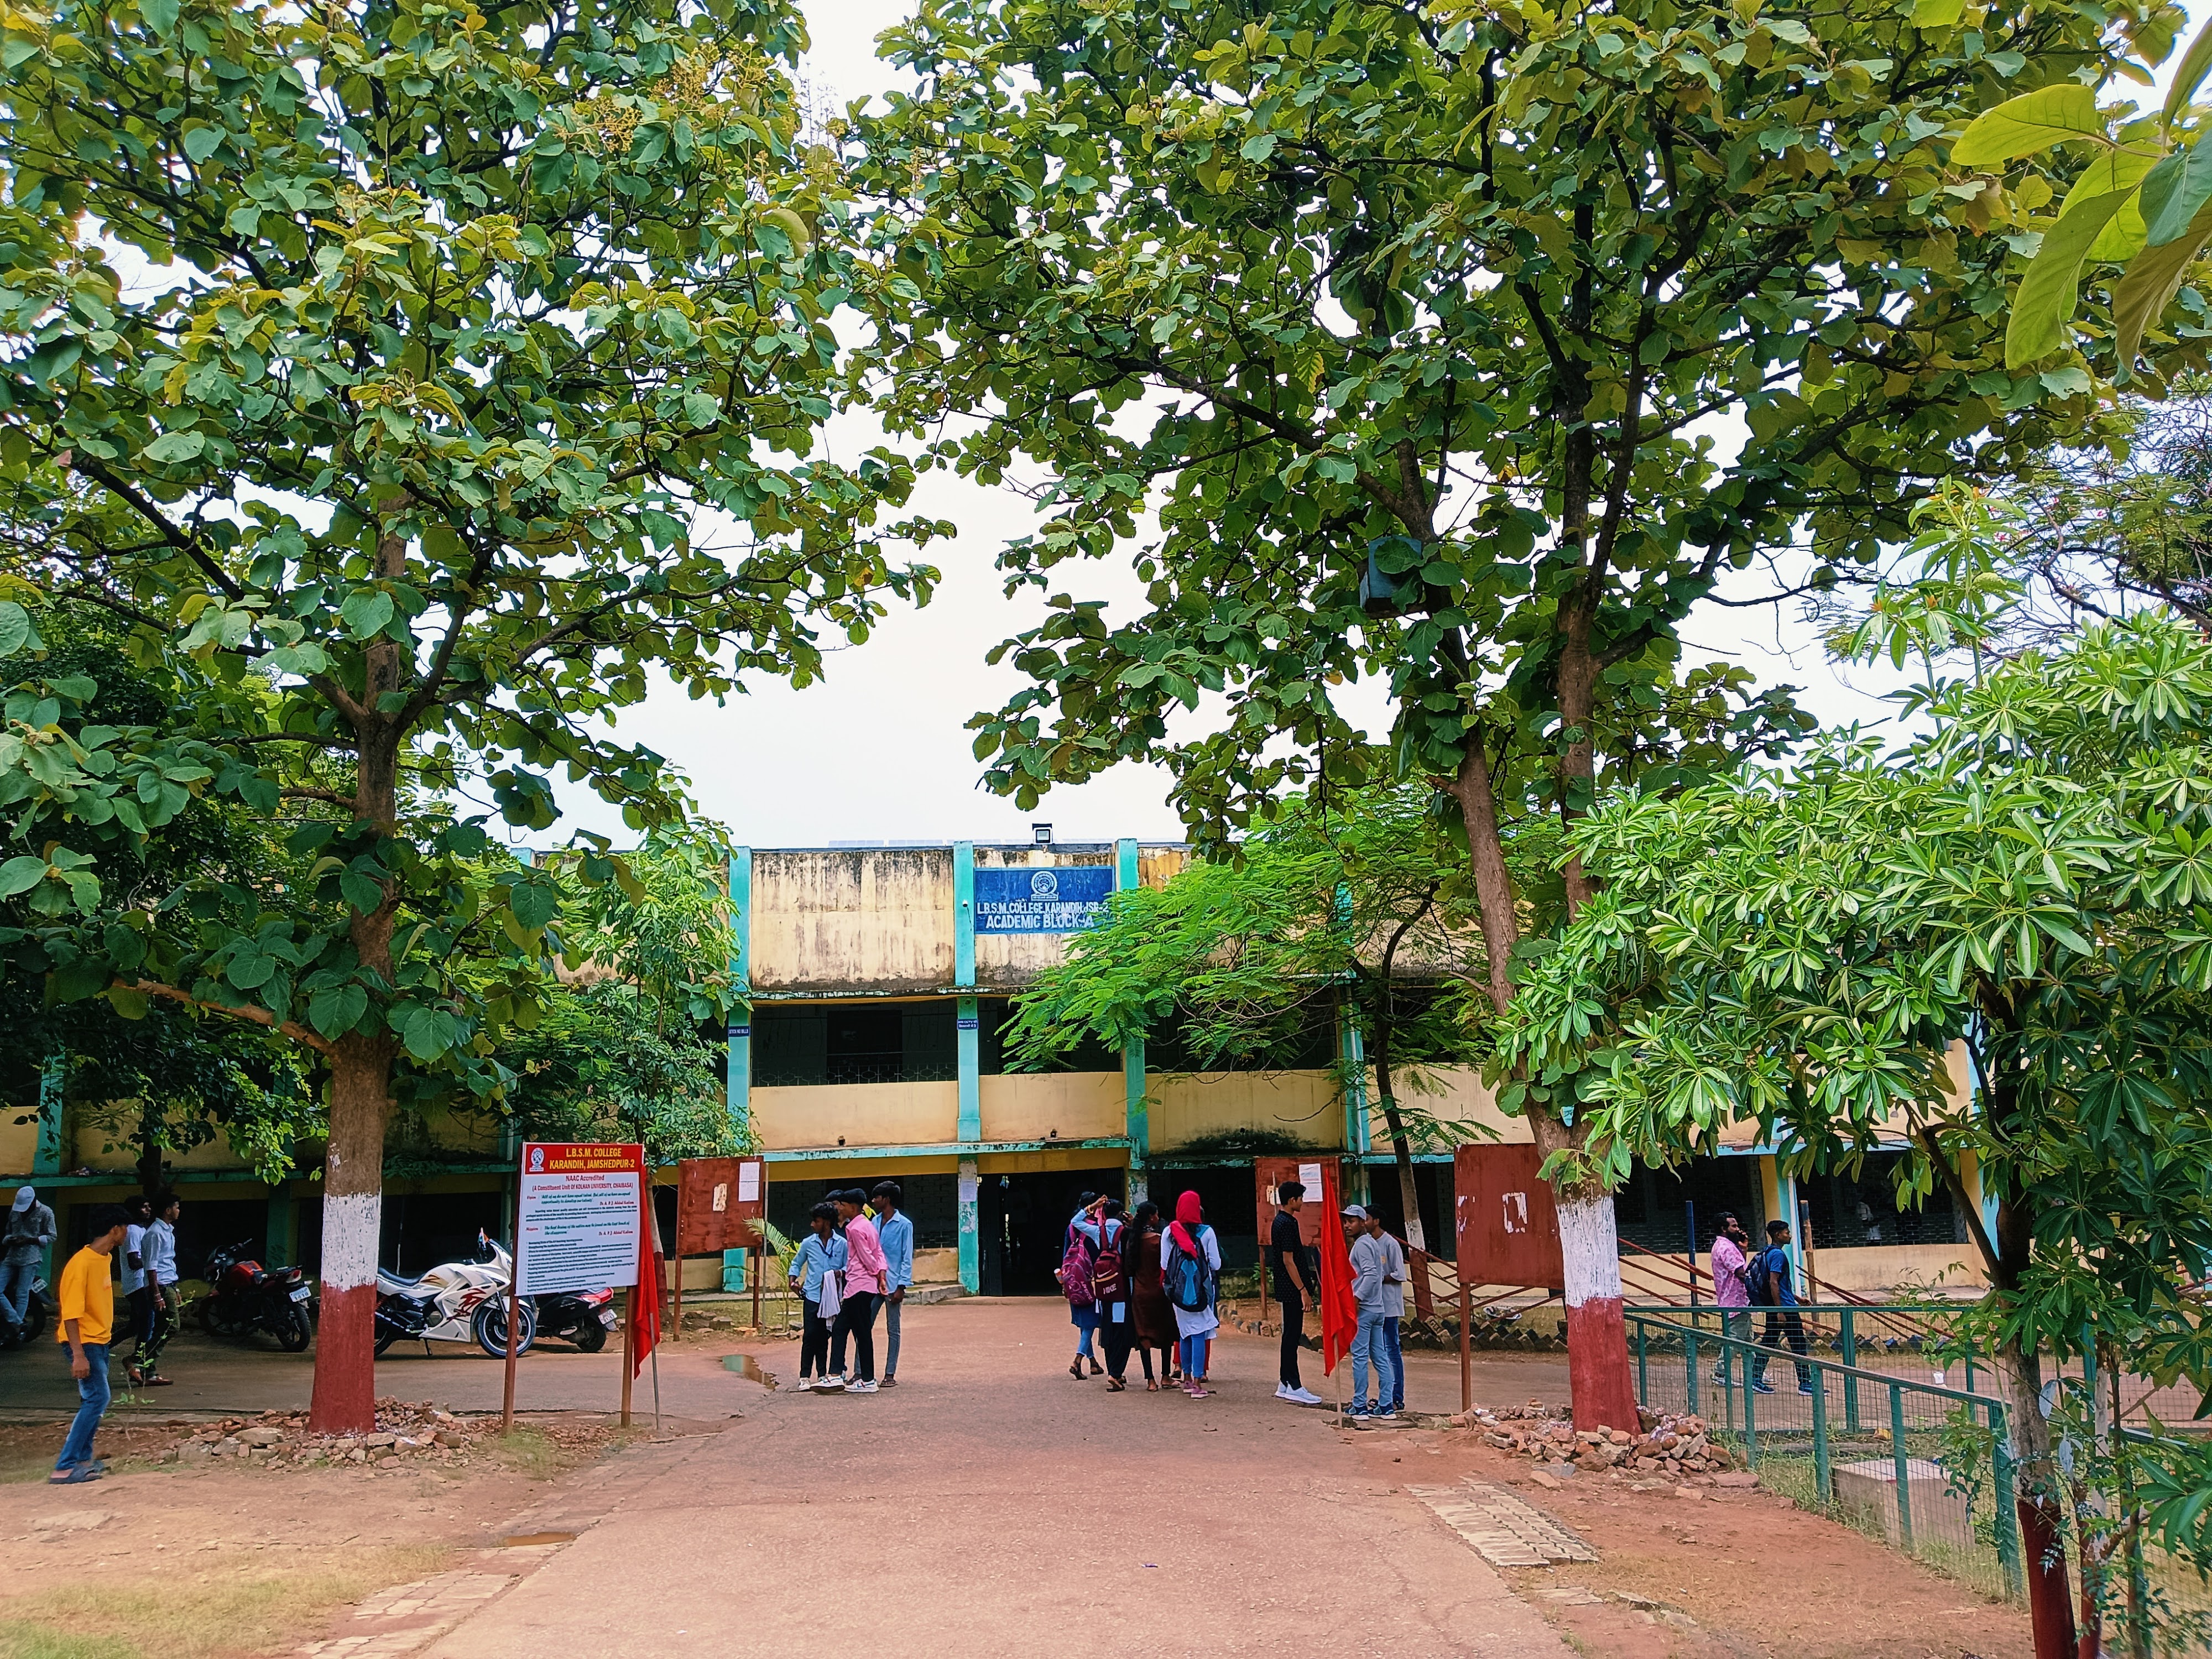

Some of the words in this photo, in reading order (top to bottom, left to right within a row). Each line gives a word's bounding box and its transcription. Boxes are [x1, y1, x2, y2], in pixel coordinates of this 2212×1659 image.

[985, 915, 1041, 928] ACADEMIC
[566, 1148, 592, 1157] L.B.S.M.
[593, 1147, 622, 1157] COLLEGE
[549, 1160, 586, 1170] KARANDIH,
[587, 1159, 635, 1168] JAMSHEDPUR-2
